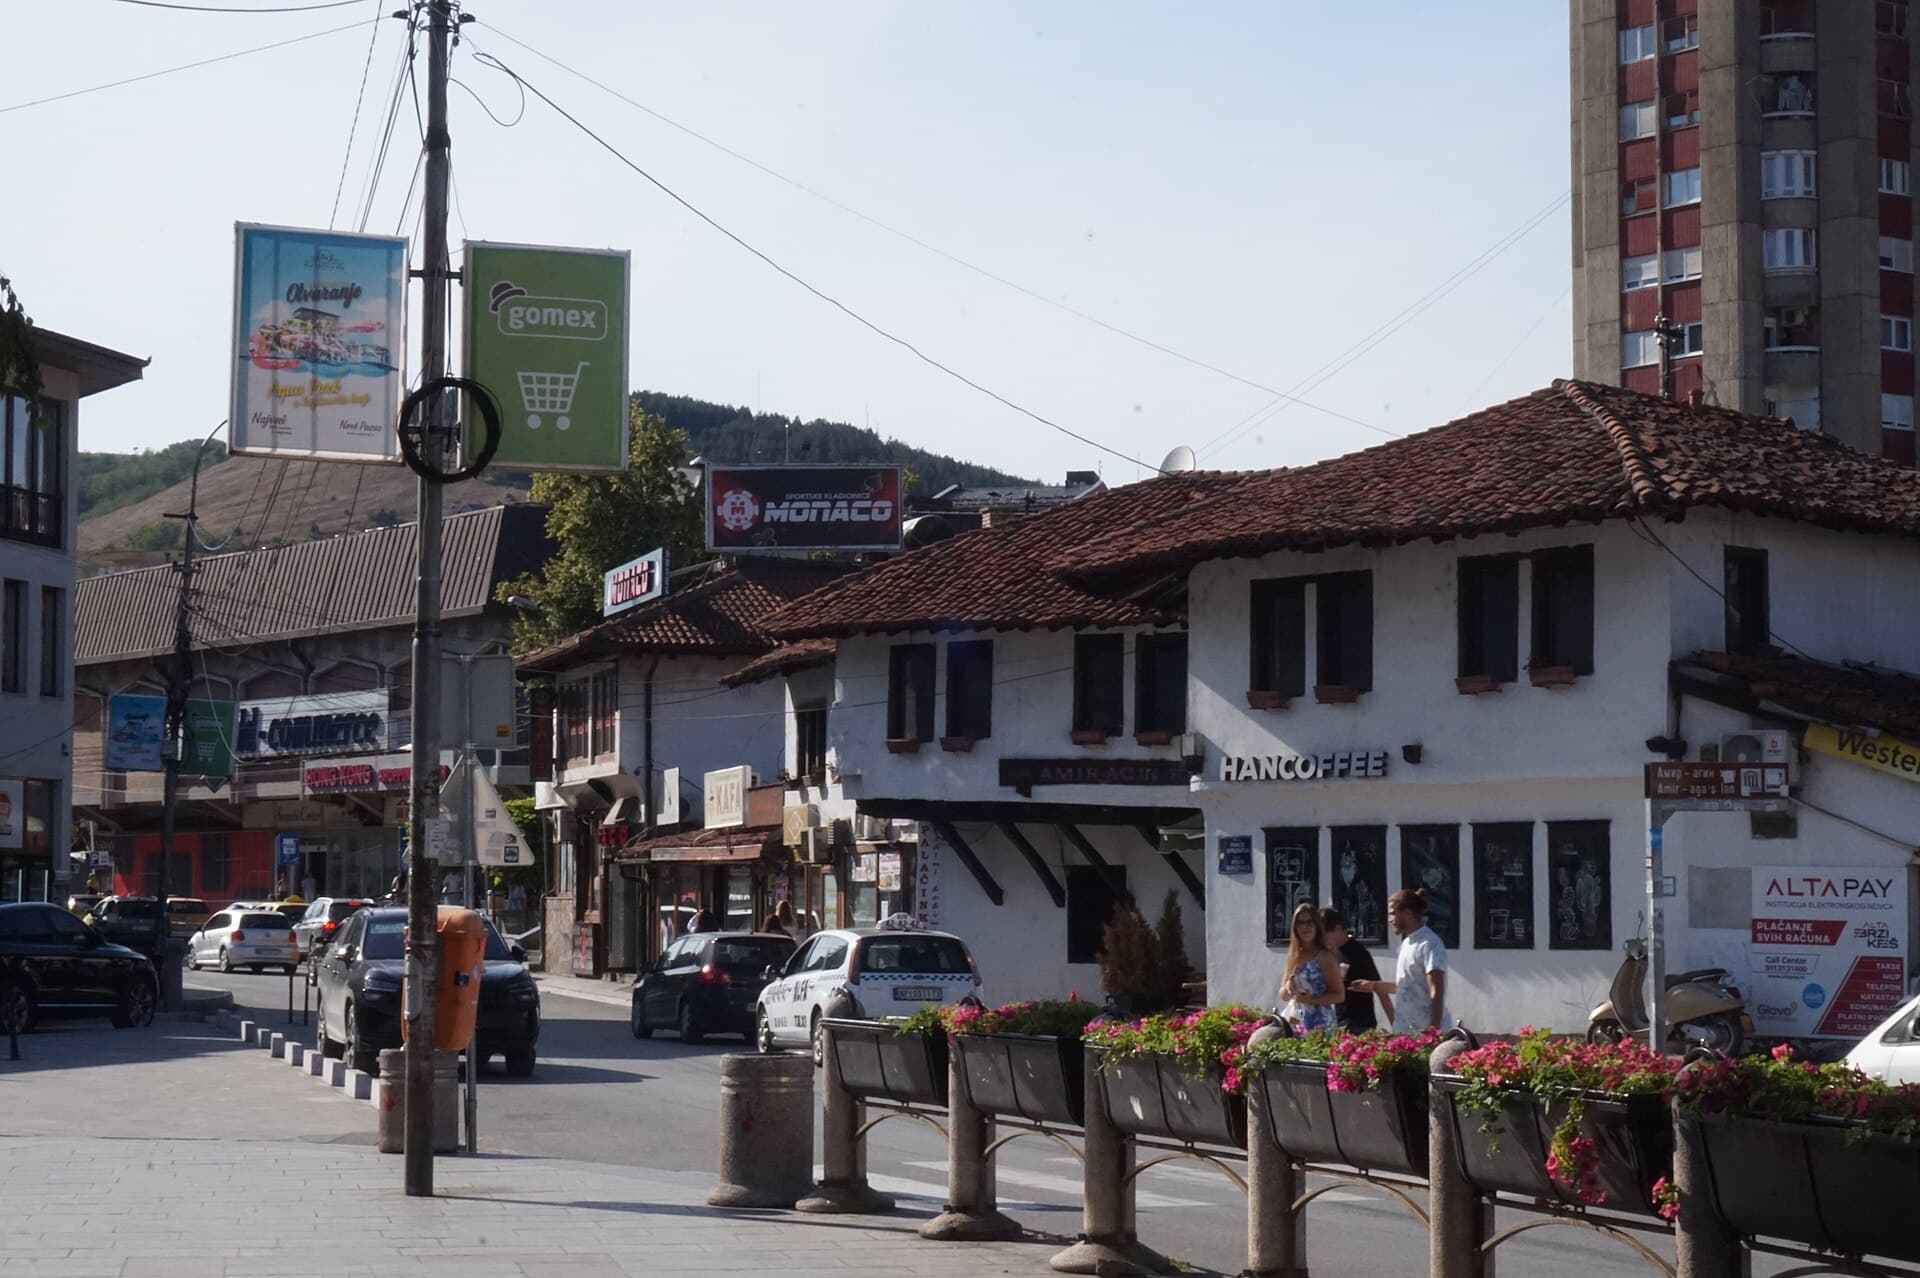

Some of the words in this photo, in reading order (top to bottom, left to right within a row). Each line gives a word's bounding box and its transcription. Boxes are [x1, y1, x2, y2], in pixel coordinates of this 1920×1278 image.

[509, 306, 596, 329] gomex
[763, 501, 893, 523] MONACO
[1219, 752, 1387, 781] HANCOFFEE
[1766, 877, 1893, 898] ALTAPAY
[1757, 933, 1782, 942] SVIH
